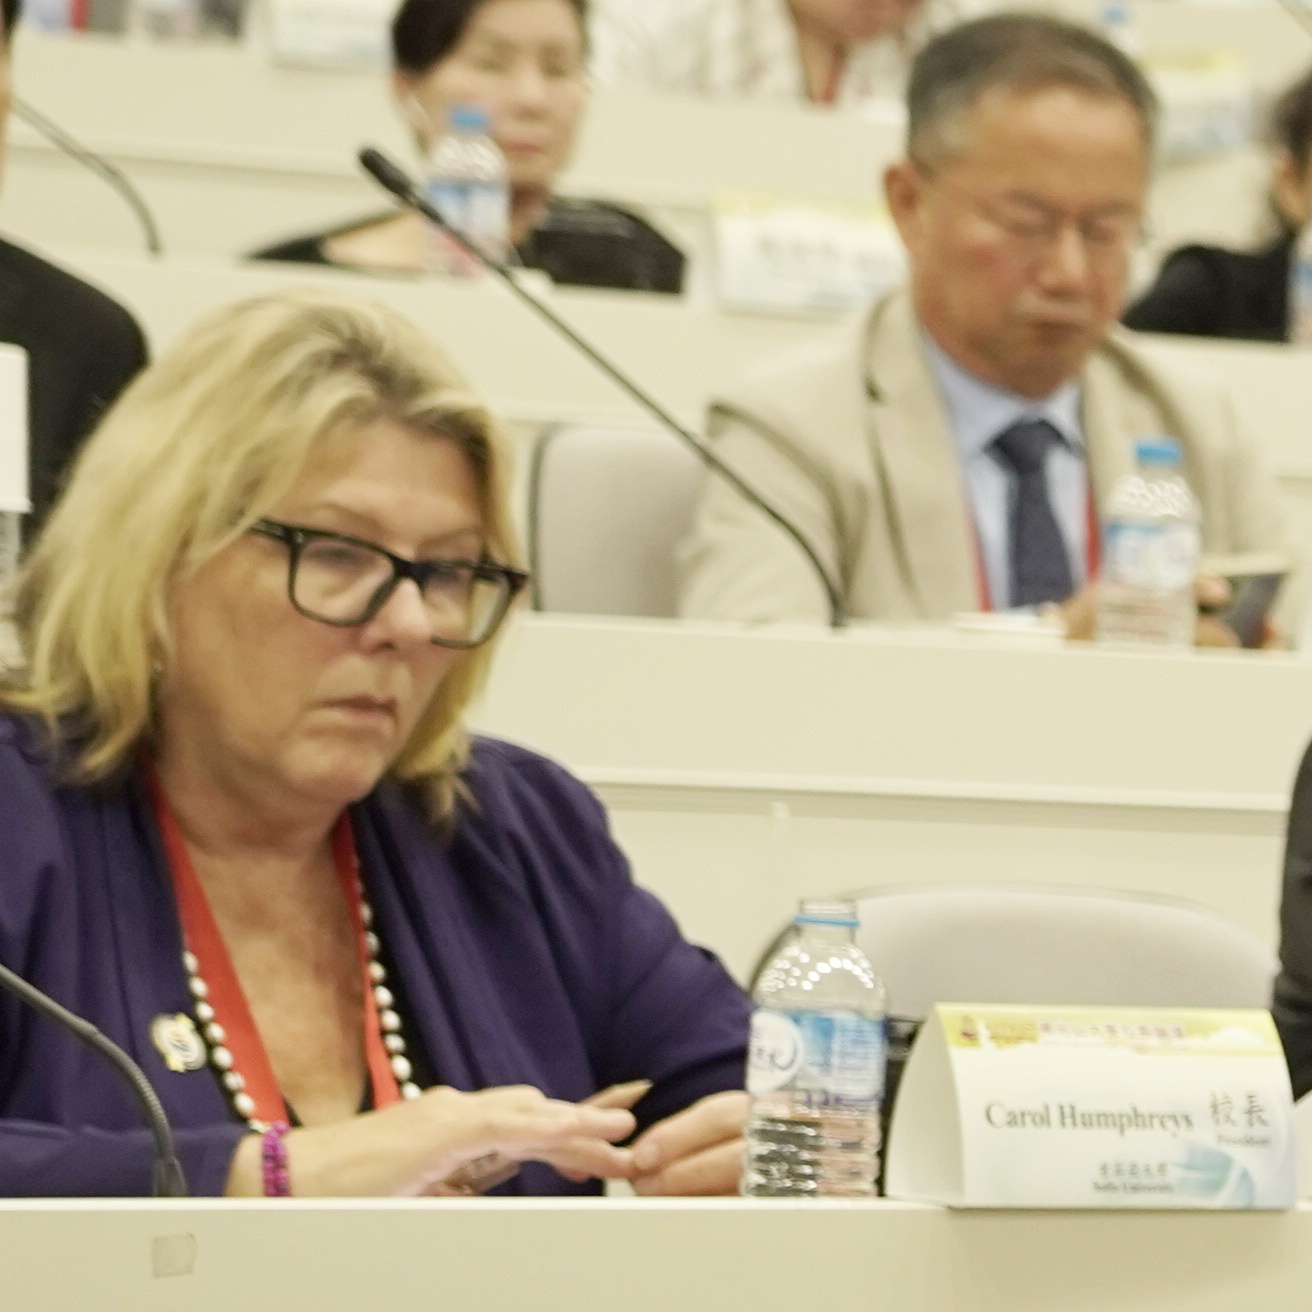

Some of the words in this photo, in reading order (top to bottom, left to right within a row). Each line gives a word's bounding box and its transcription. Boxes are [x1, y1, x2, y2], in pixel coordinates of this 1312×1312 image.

[984, 1101, 1050, 1130] Carol
[1058, 1103, 1195, 1138] Humphreys
[1209, 1092, 1270, 1129] 校長
